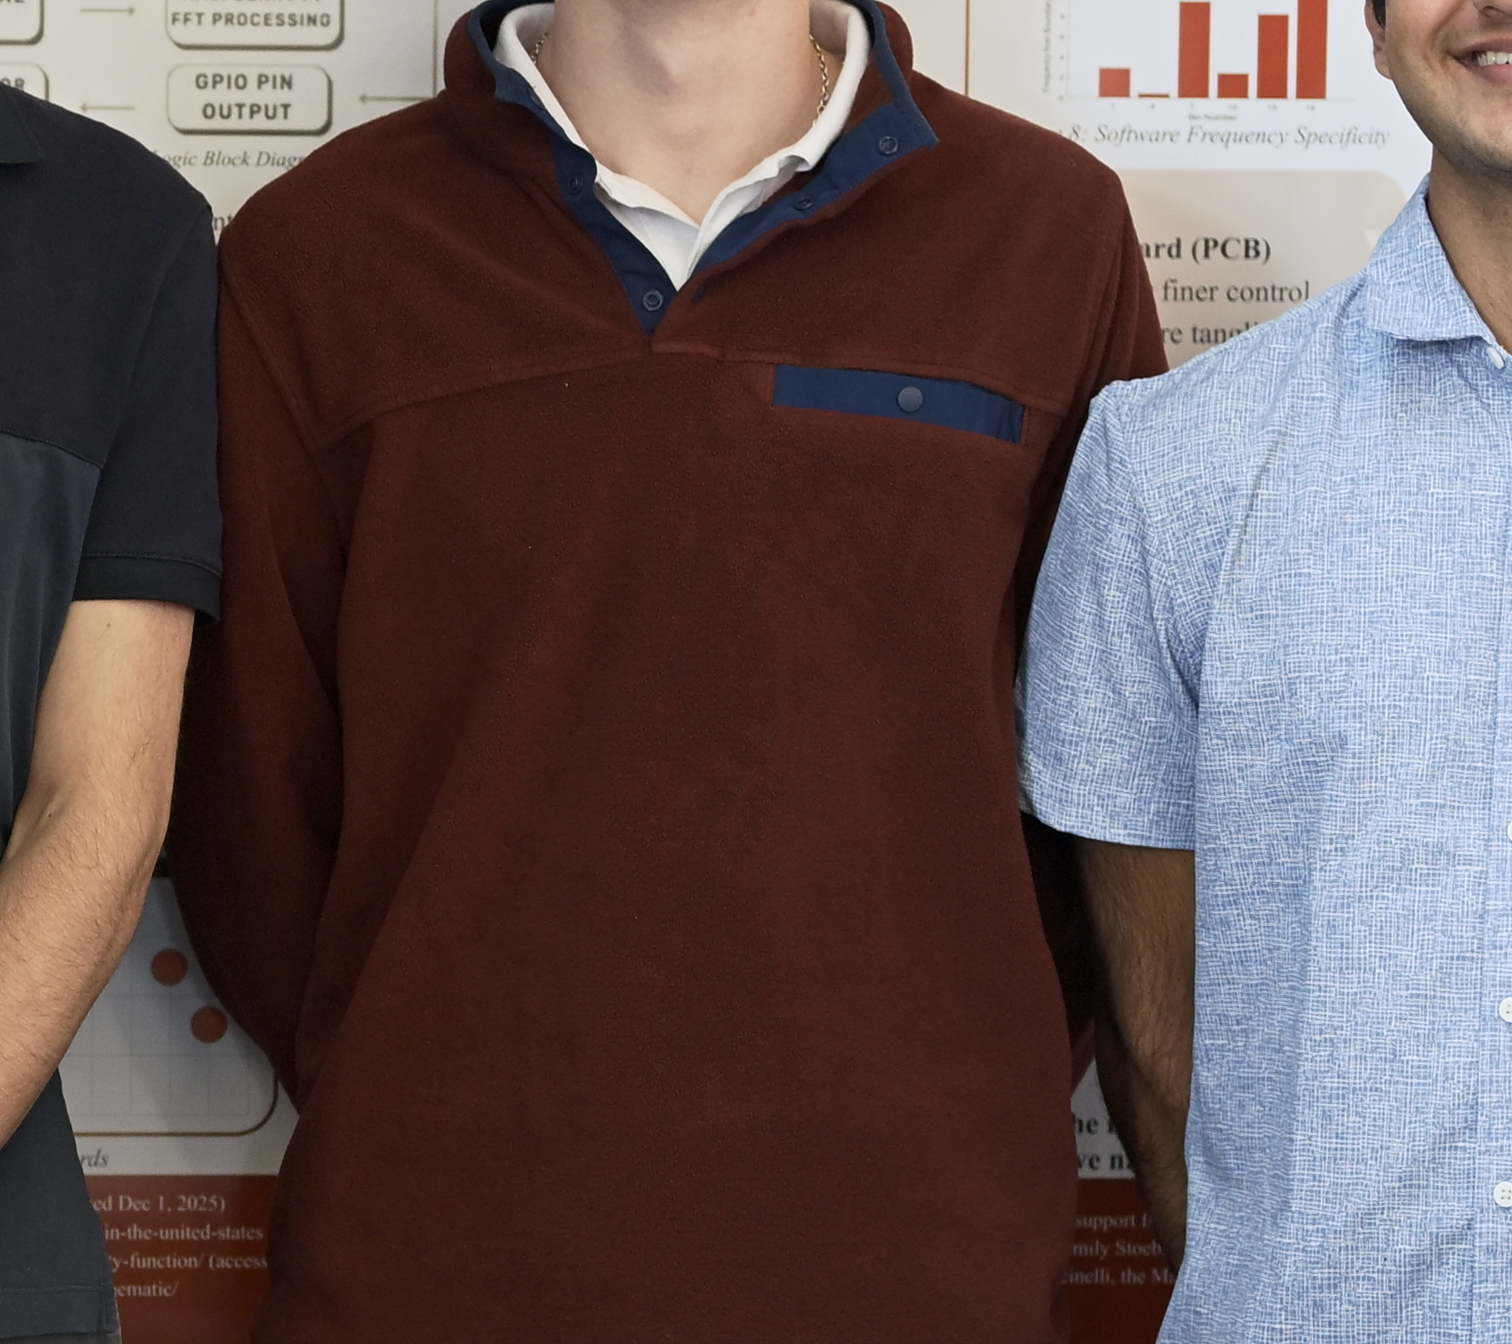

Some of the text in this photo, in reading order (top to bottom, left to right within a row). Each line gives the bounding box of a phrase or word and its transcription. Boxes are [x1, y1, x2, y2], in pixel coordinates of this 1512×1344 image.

[171, 13, 331, 27] FFT PROCESSING
[194, 72, 294, 91] GPIO PIN
[201, 102, 292, 121] OUTPUT
[1093, 123, 1390, 150] Software Frequency Specificity
[1190, 237, 1271, 264] (PCB)
[1162, 278, 1310, 305] finer control
[119, 1196, 151, 1212] Dec
[177, 1196, 226, 1212] 2025)
